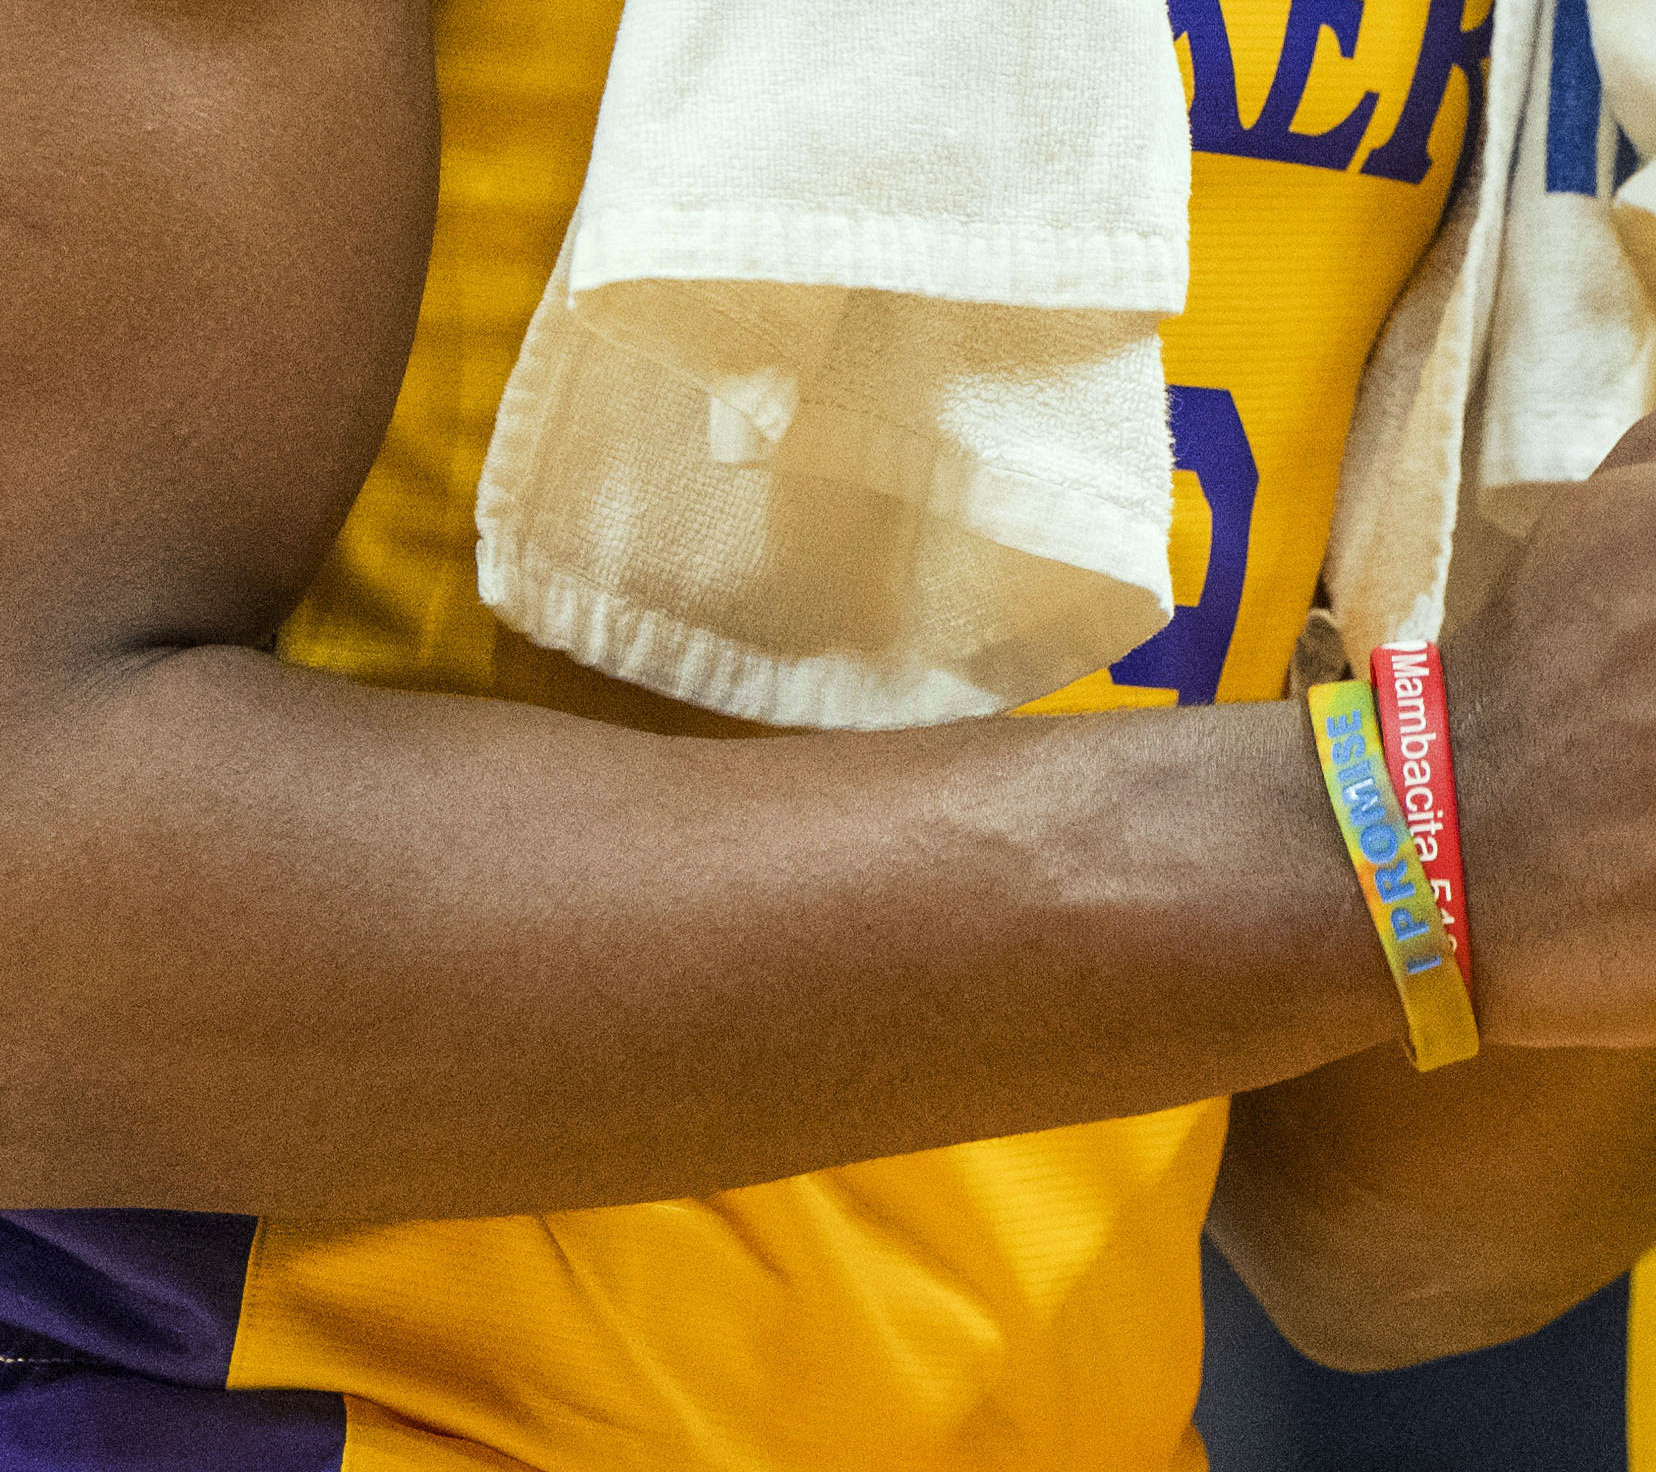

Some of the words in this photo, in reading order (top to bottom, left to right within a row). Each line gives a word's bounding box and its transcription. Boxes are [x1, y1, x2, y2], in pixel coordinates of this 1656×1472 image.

[1325, 708, 1430, 942] PROMISE
[1391, 652, 1439, 863] Mambacita
[1405, 955, 1442, 974] I
